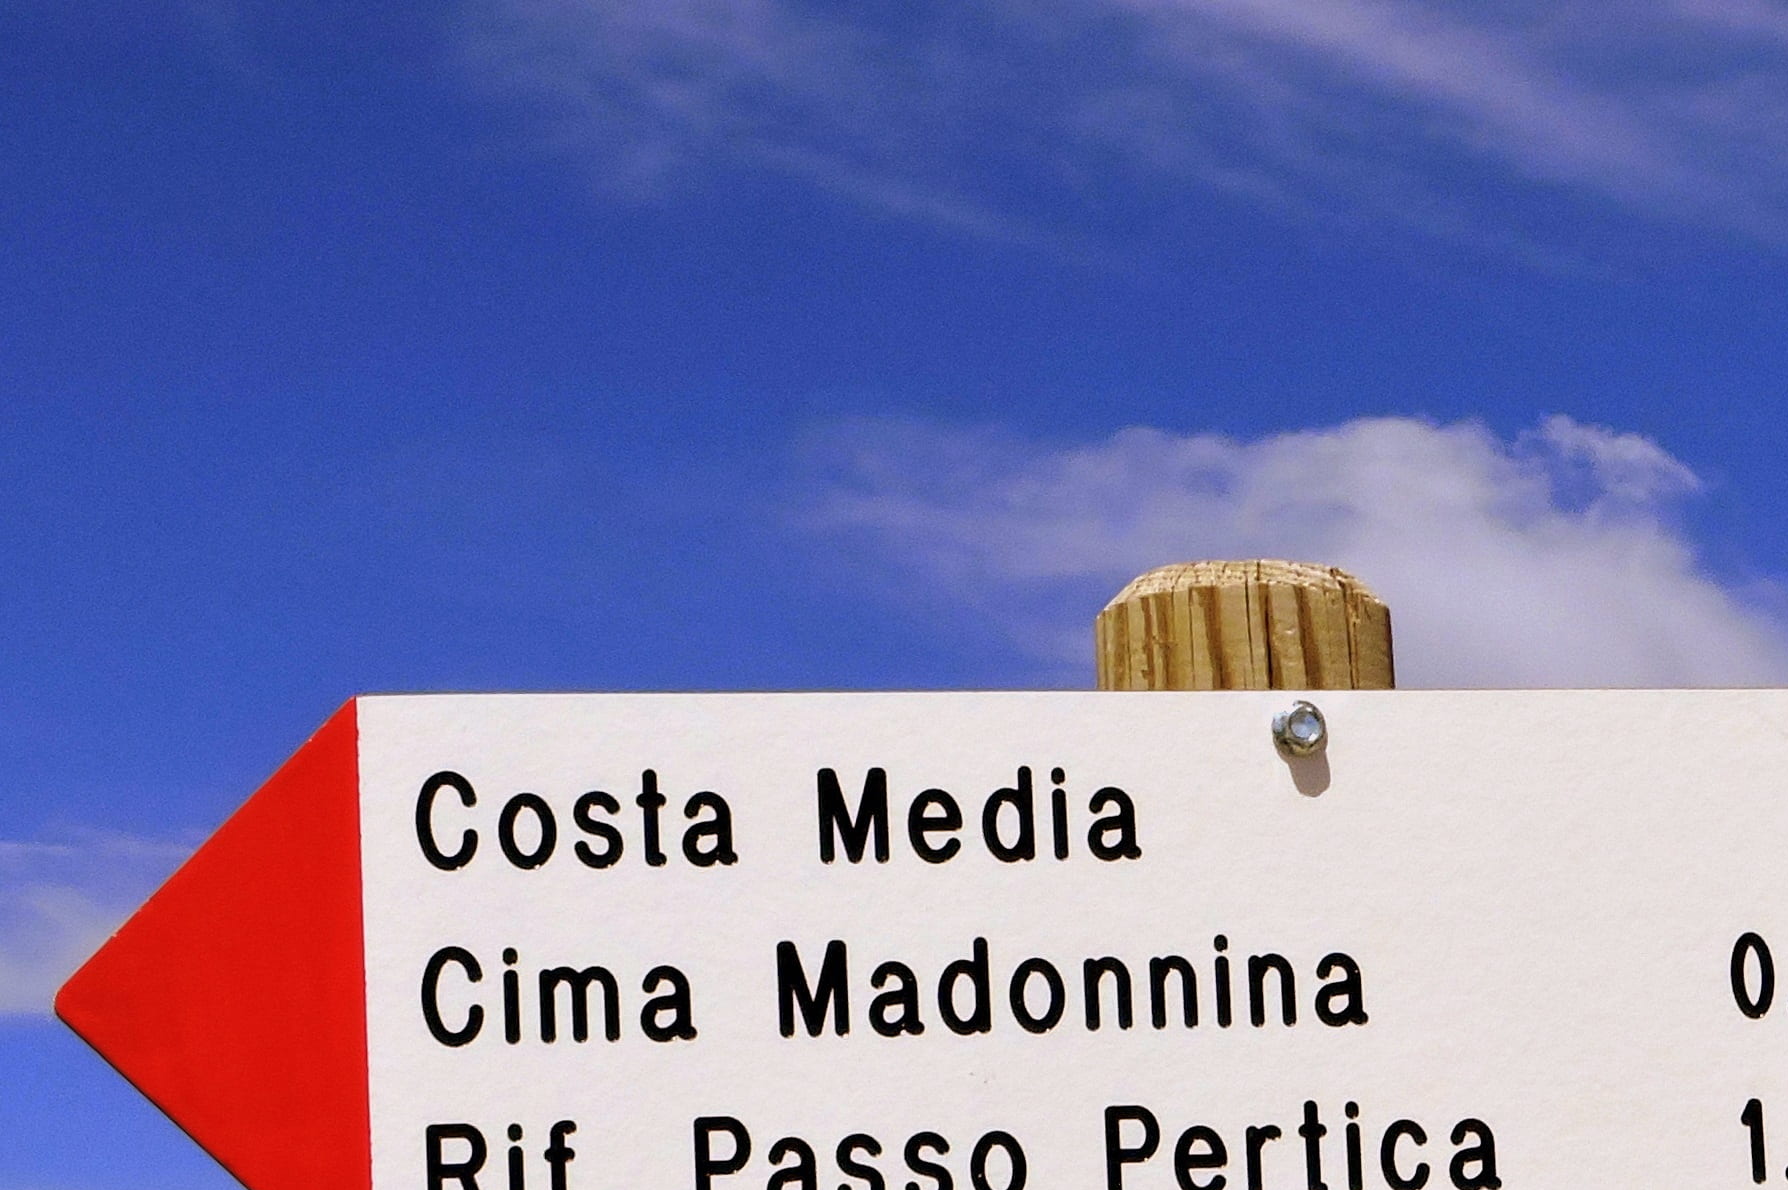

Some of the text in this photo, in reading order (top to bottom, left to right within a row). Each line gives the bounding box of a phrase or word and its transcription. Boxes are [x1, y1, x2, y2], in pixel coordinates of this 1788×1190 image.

[416, 765, 1142, 872] Costa Media
[421, 945, 698, 1048] Cima
[776, 936, 1369, 1039] Madonnina
